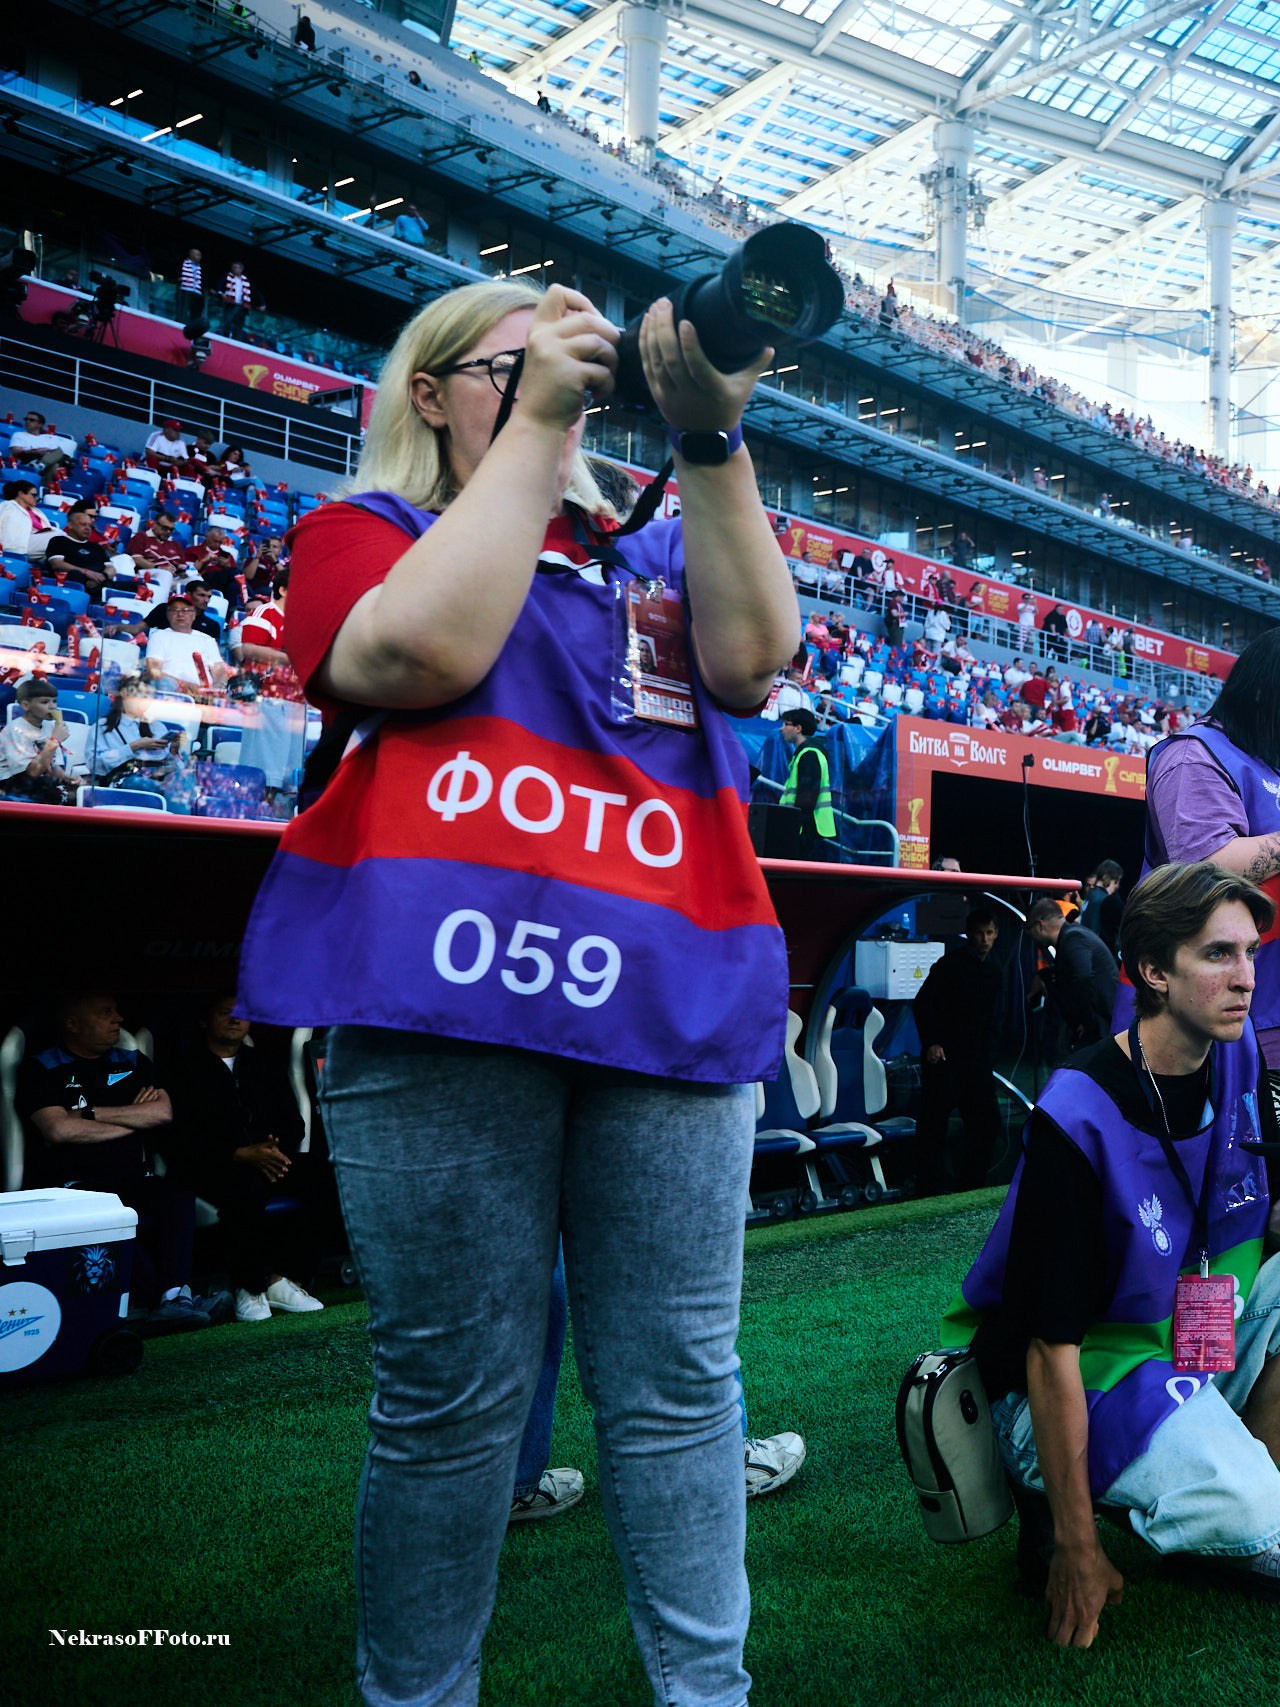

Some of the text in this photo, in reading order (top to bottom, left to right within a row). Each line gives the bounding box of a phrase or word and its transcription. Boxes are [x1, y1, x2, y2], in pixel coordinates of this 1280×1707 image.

[426, 751, 683, 868] ФОТО
[1042, 757, 1102, 778] OLIMPBET
[433, 909, 622, 1008] 059
